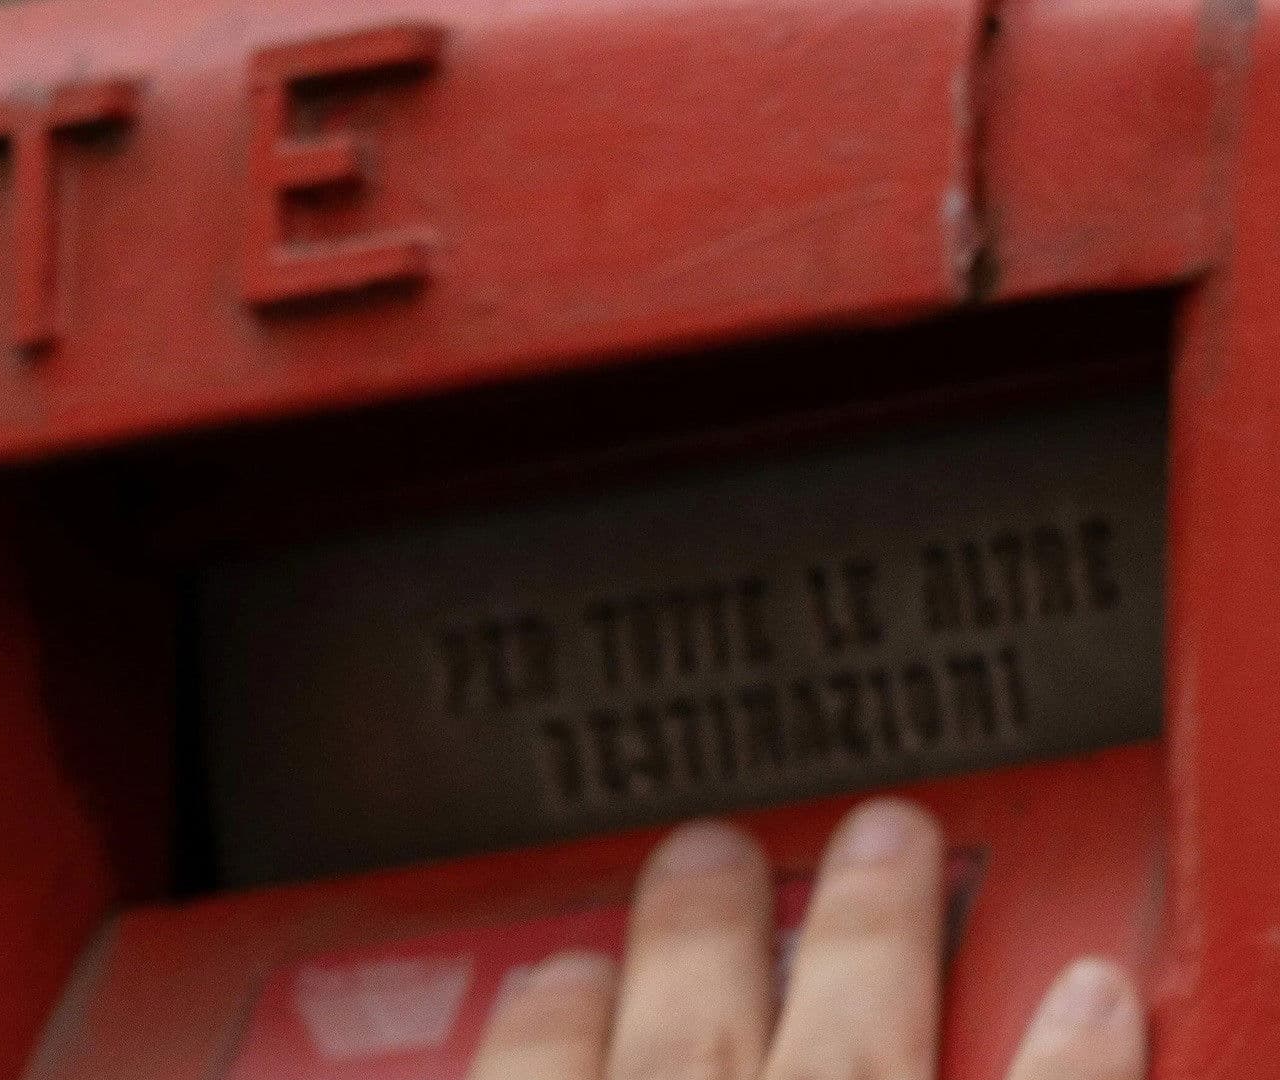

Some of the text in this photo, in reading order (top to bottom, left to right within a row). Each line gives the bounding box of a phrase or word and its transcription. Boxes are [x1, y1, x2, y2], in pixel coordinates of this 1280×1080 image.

[587, 573, 782, 690] TUTTE
[806, 555, 886, 658] LE
[918, 515, 1123, 633] ALTRE
[538, 645, 1030, 802] DESTINAZIONI
